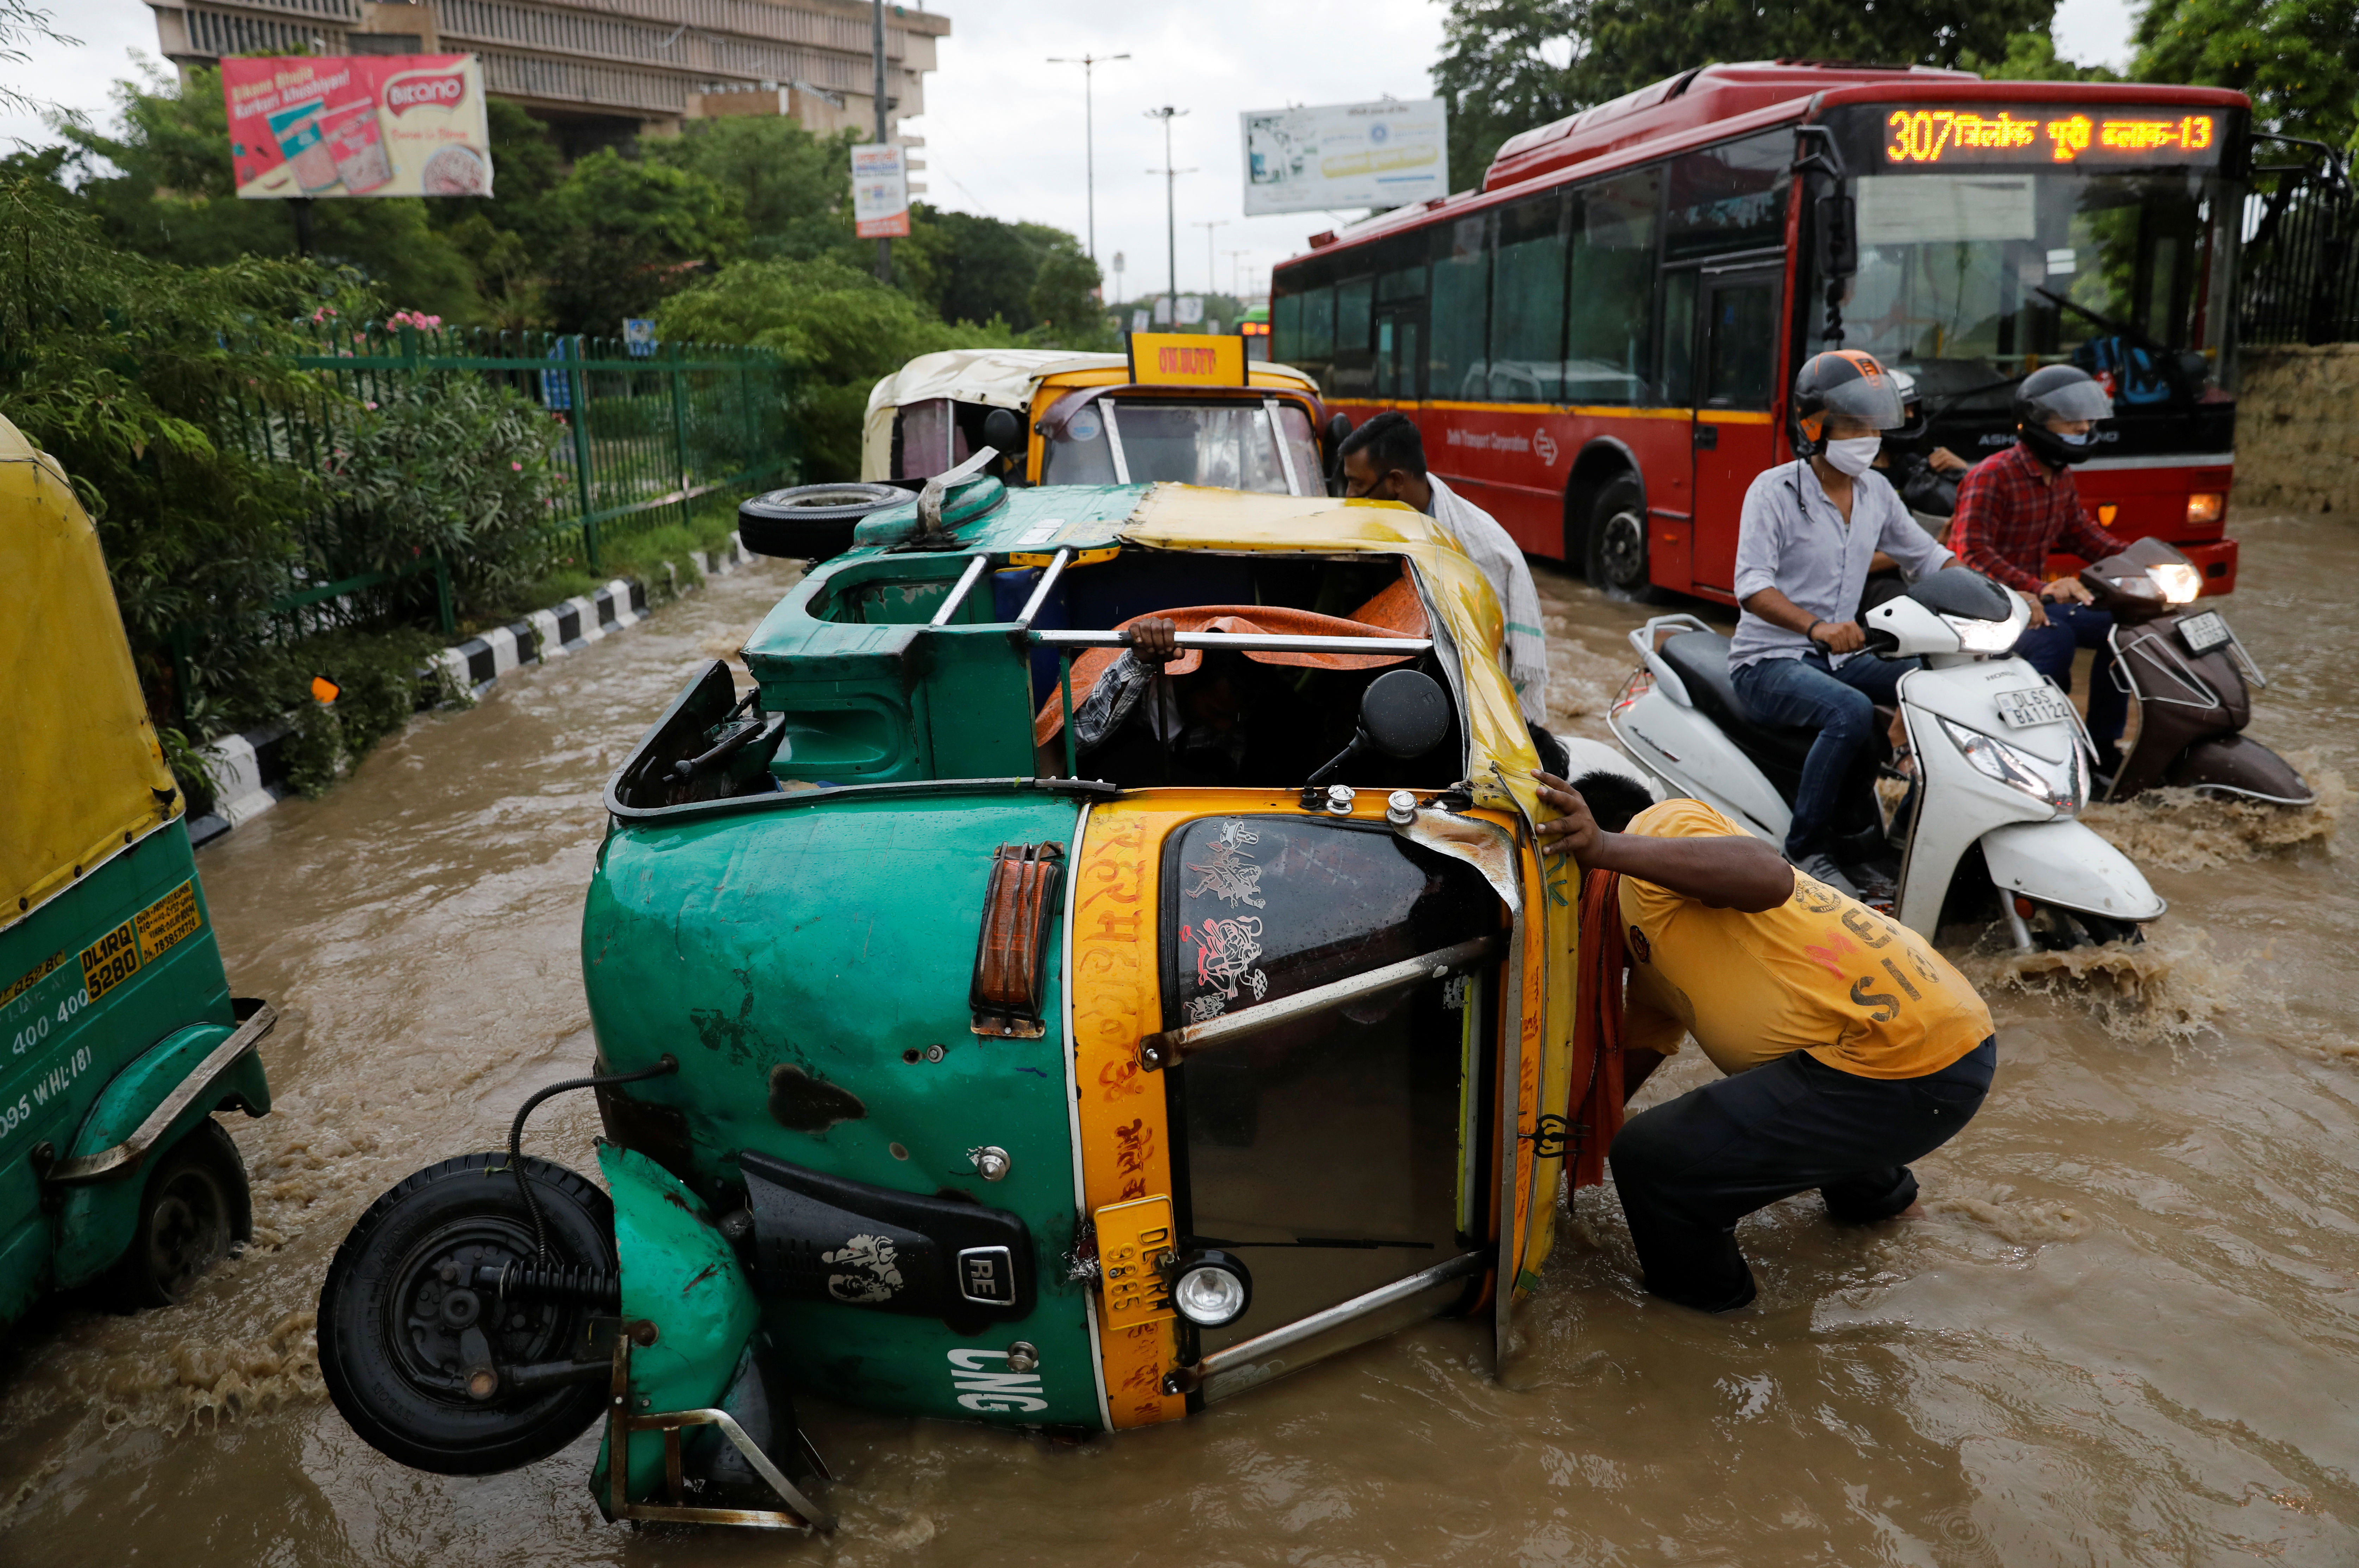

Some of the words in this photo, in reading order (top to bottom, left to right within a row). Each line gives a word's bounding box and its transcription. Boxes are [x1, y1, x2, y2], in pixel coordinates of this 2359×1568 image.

[1888, 111, 1955, 160] 307
[1159, 347, 1178, 374] ON
[1180, 347, 1216, 375] DUTY
[2012, 689, 2051, 708] DL6S
[2013, 703, 2070, 724] BA1122
[82, 926, 134, 973] DL1RQ
[88, 951, 137, 1000] 5280
[969, 1259, 996, 1295] RE
[1106, 1241, 1141, 1312] 9885
[946, 1348, 1049, 1412] CNG
